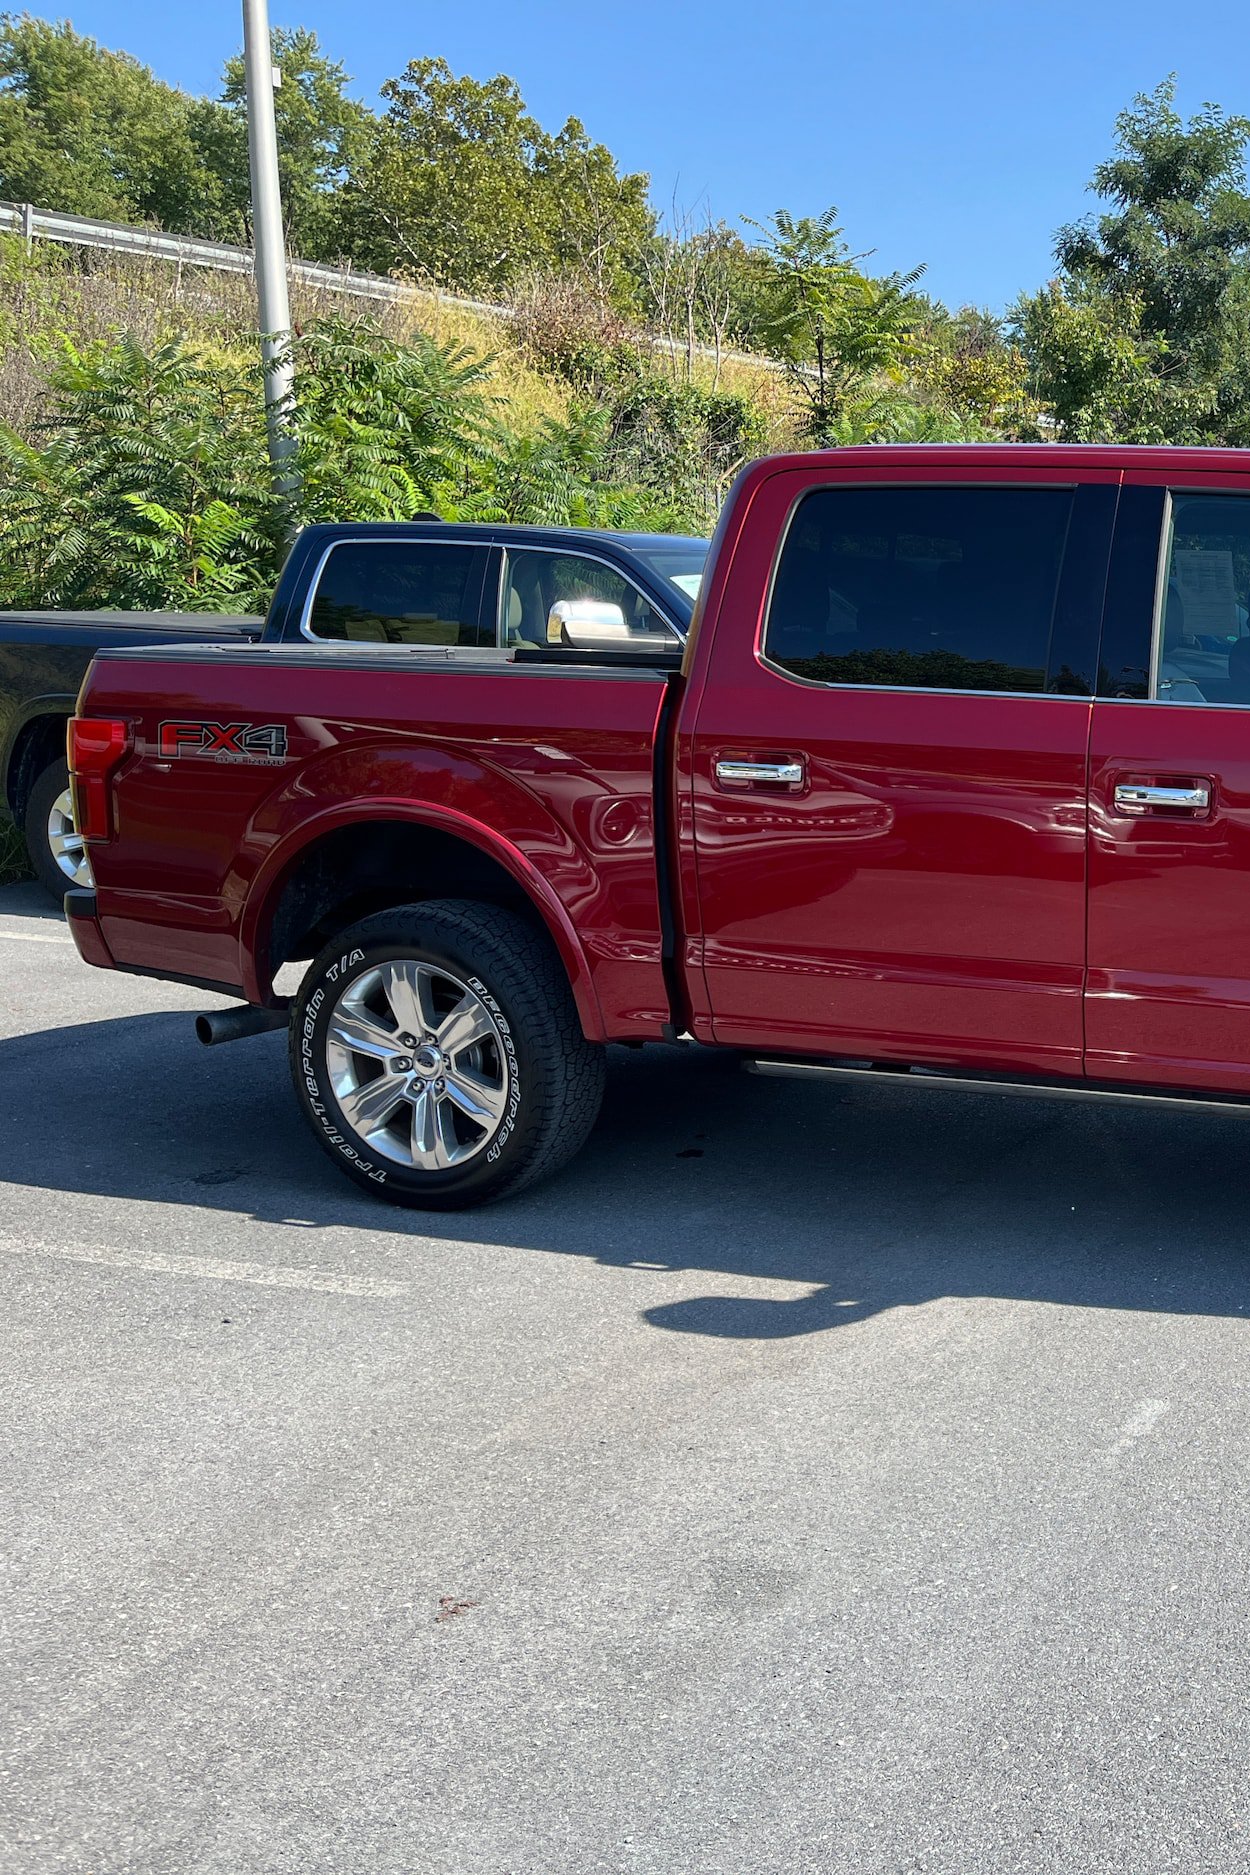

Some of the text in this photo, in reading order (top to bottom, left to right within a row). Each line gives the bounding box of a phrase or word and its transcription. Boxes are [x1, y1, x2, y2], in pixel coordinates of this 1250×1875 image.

[158, 719, 288, 759] FX4
[302, 948, 387, 1183] Trail-Terrain T/A
[467, 976, 521, 1163] BFGoodrich
